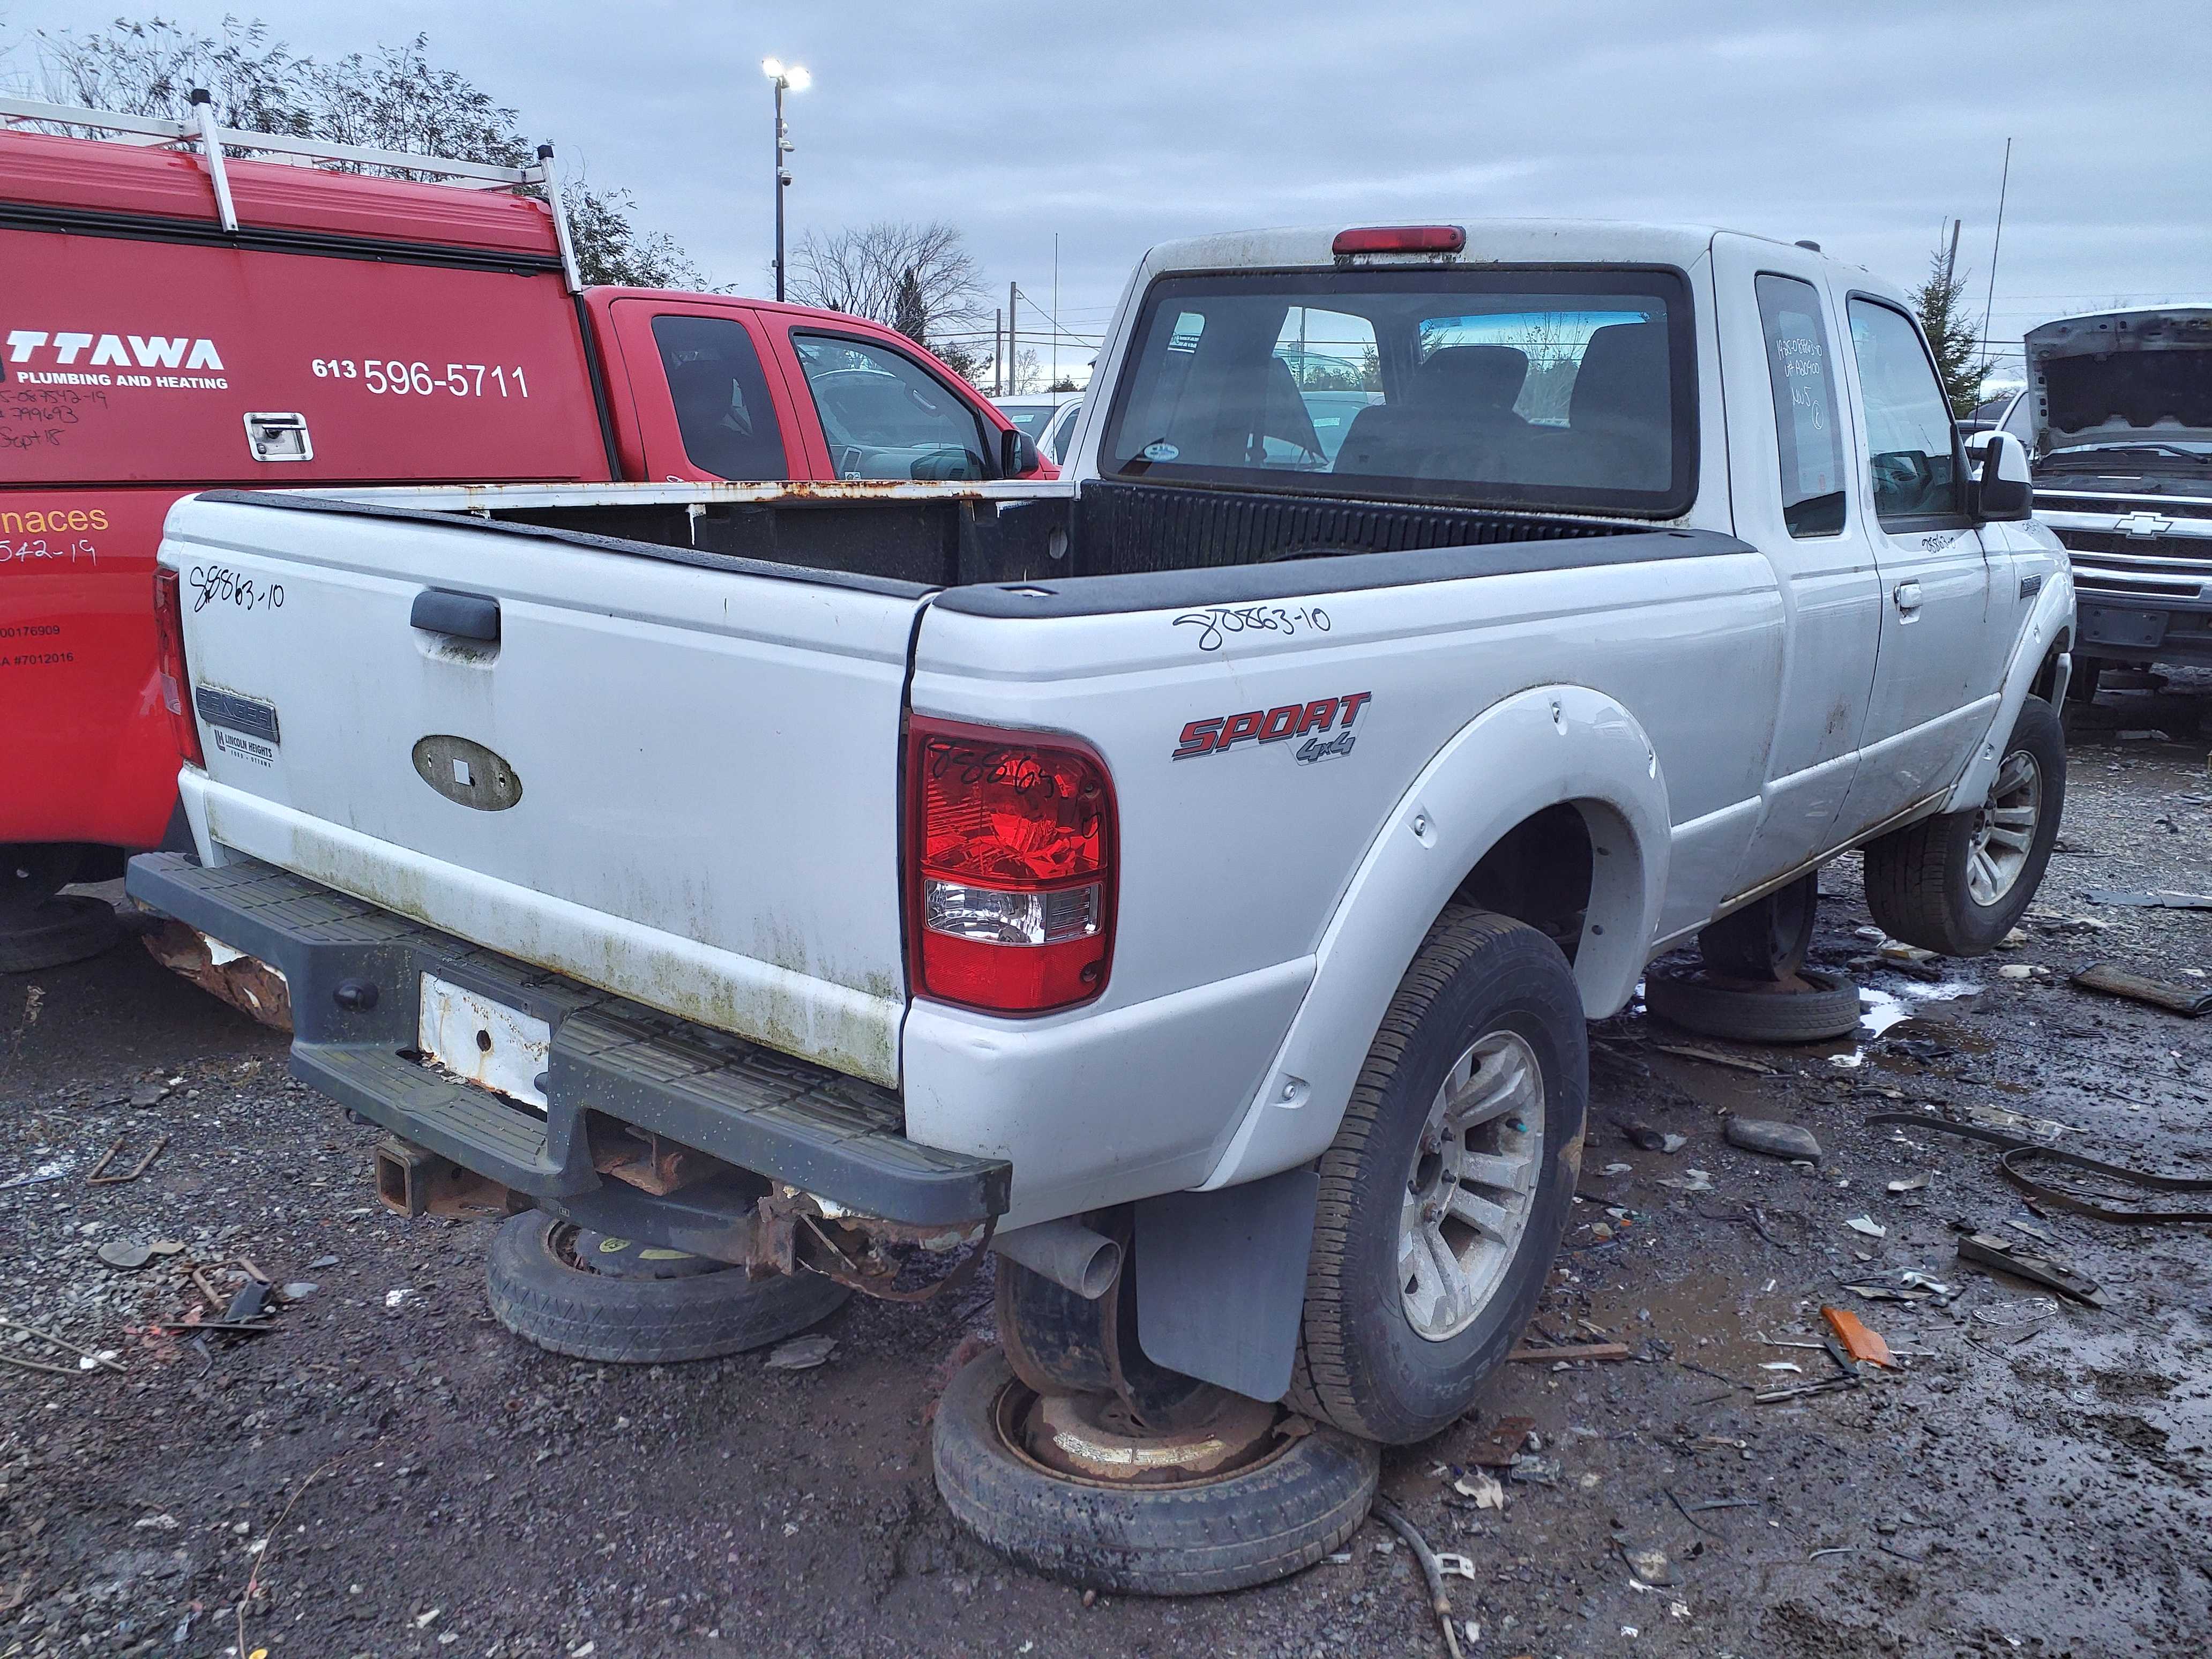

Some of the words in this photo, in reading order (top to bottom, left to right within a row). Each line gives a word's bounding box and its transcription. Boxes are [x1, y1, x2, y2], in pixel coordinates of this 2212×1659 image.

[6, 331, 224, 371] TTAWA
[17, 371, 111, 386] PLUMBING
[116, 375, 151, 387] AND
[155, 376, 228, 390] HEATING
[312, 359, 357, 378] 613
[364, 360, 528, 398] 596-5711
[1, 509, 109, 534] naces
[0, 656, 10, 666] A
[14, 652, 74, 666] #7012016
[1172, 691, 1372, 761] SPORT
[225, 734, 248, 750] LINCOLN
[249, 742, 272, 758] HEIGHTS
